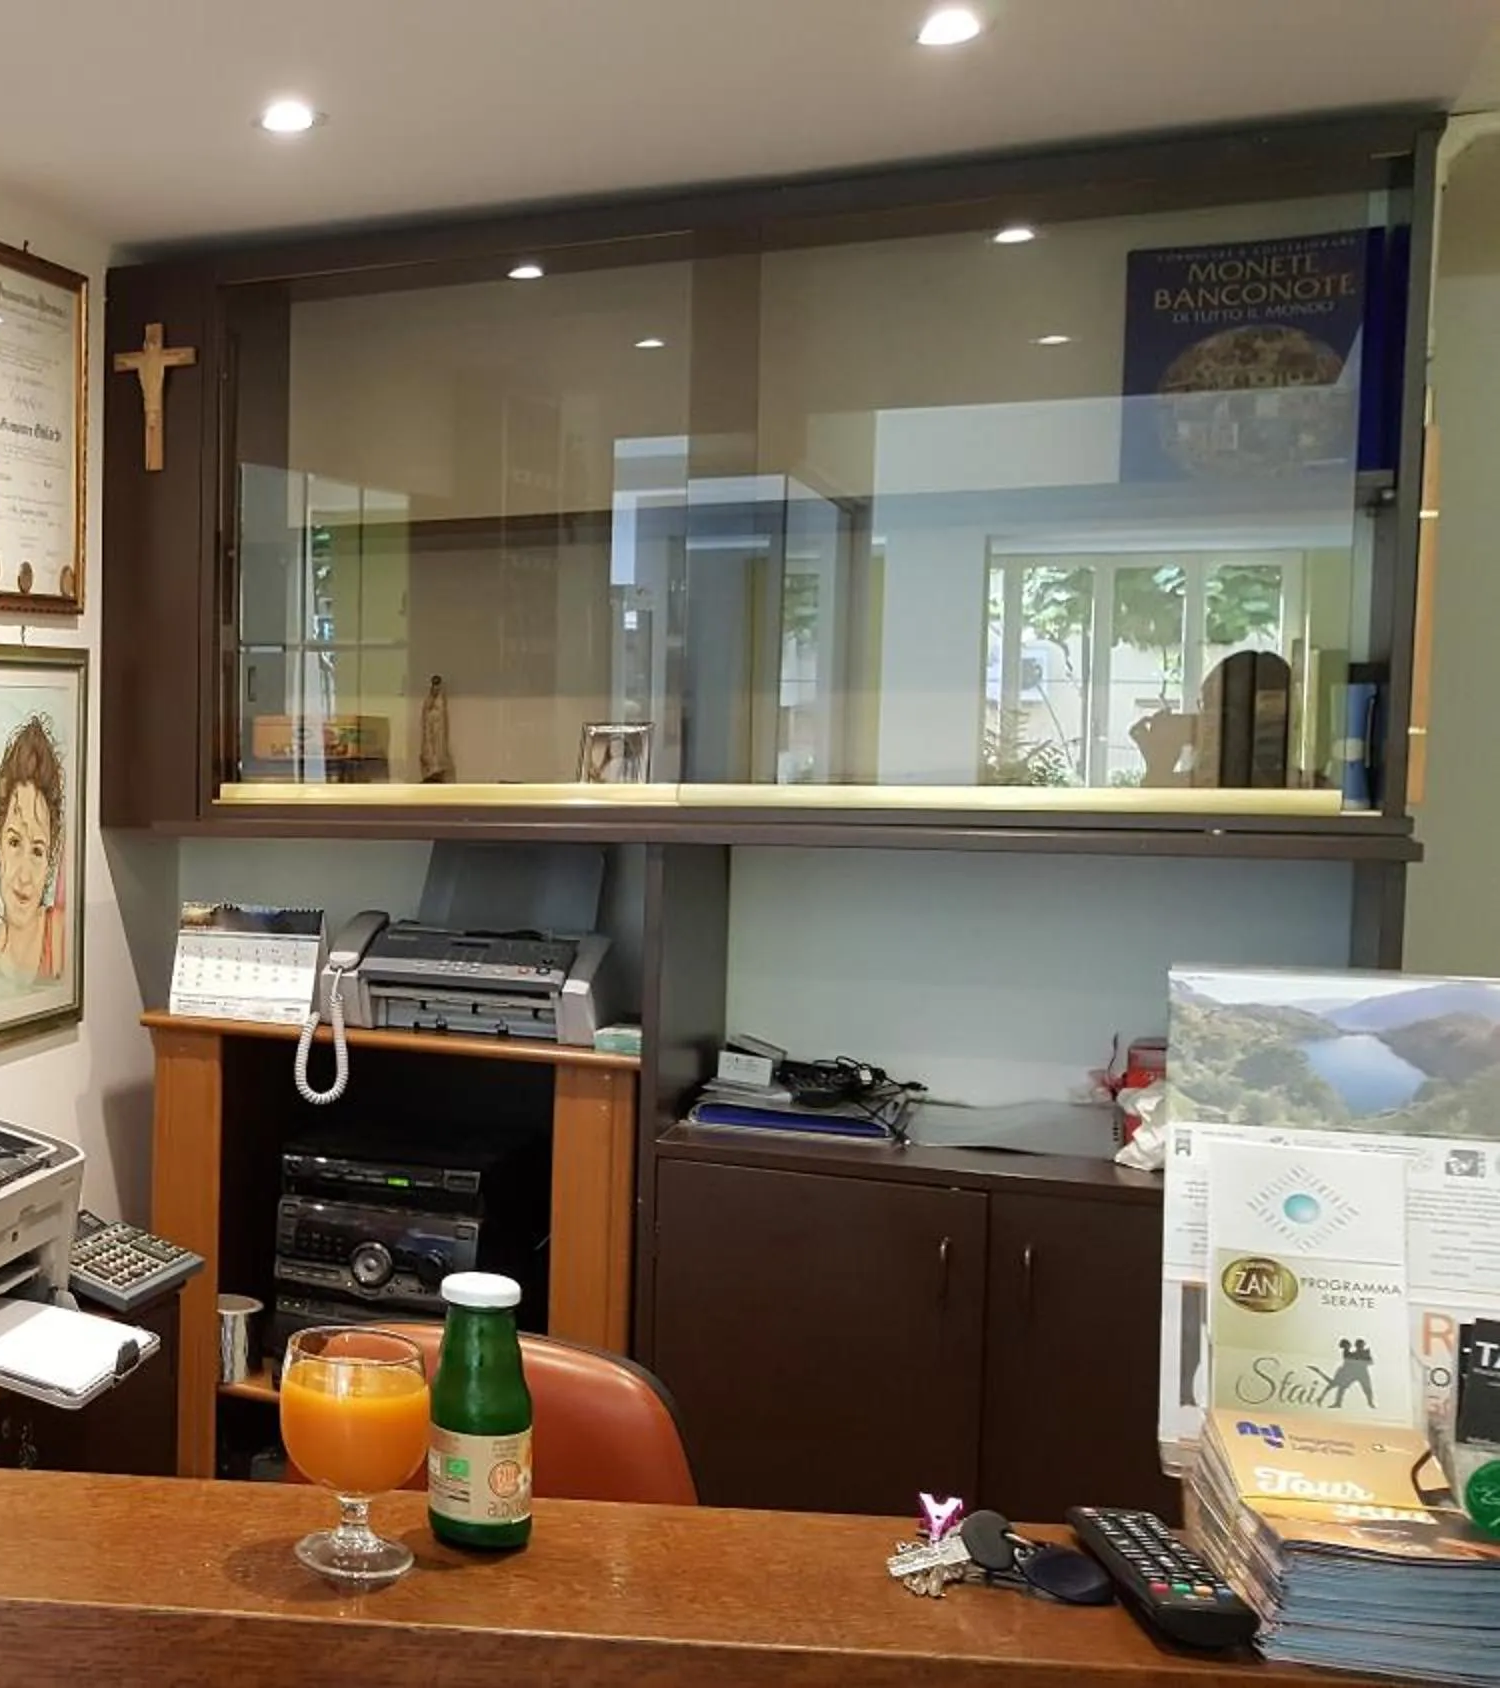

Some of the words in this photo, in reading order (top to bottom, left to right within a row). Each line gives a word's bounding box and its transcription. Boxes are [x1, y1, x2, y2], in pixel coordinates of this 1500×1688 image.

[1187, 252, 1320, 285] MONETE
[1154, 272, 1357, 311] BANCONOTE
[1235, 1271, 1284, 1298] ZANI
[1300, 1277, 1403, 1295] PROGRAMMA
[1320, 1293, 1376, 1309] SERATE
[1253, 1465, 1376, 1501] Tour
